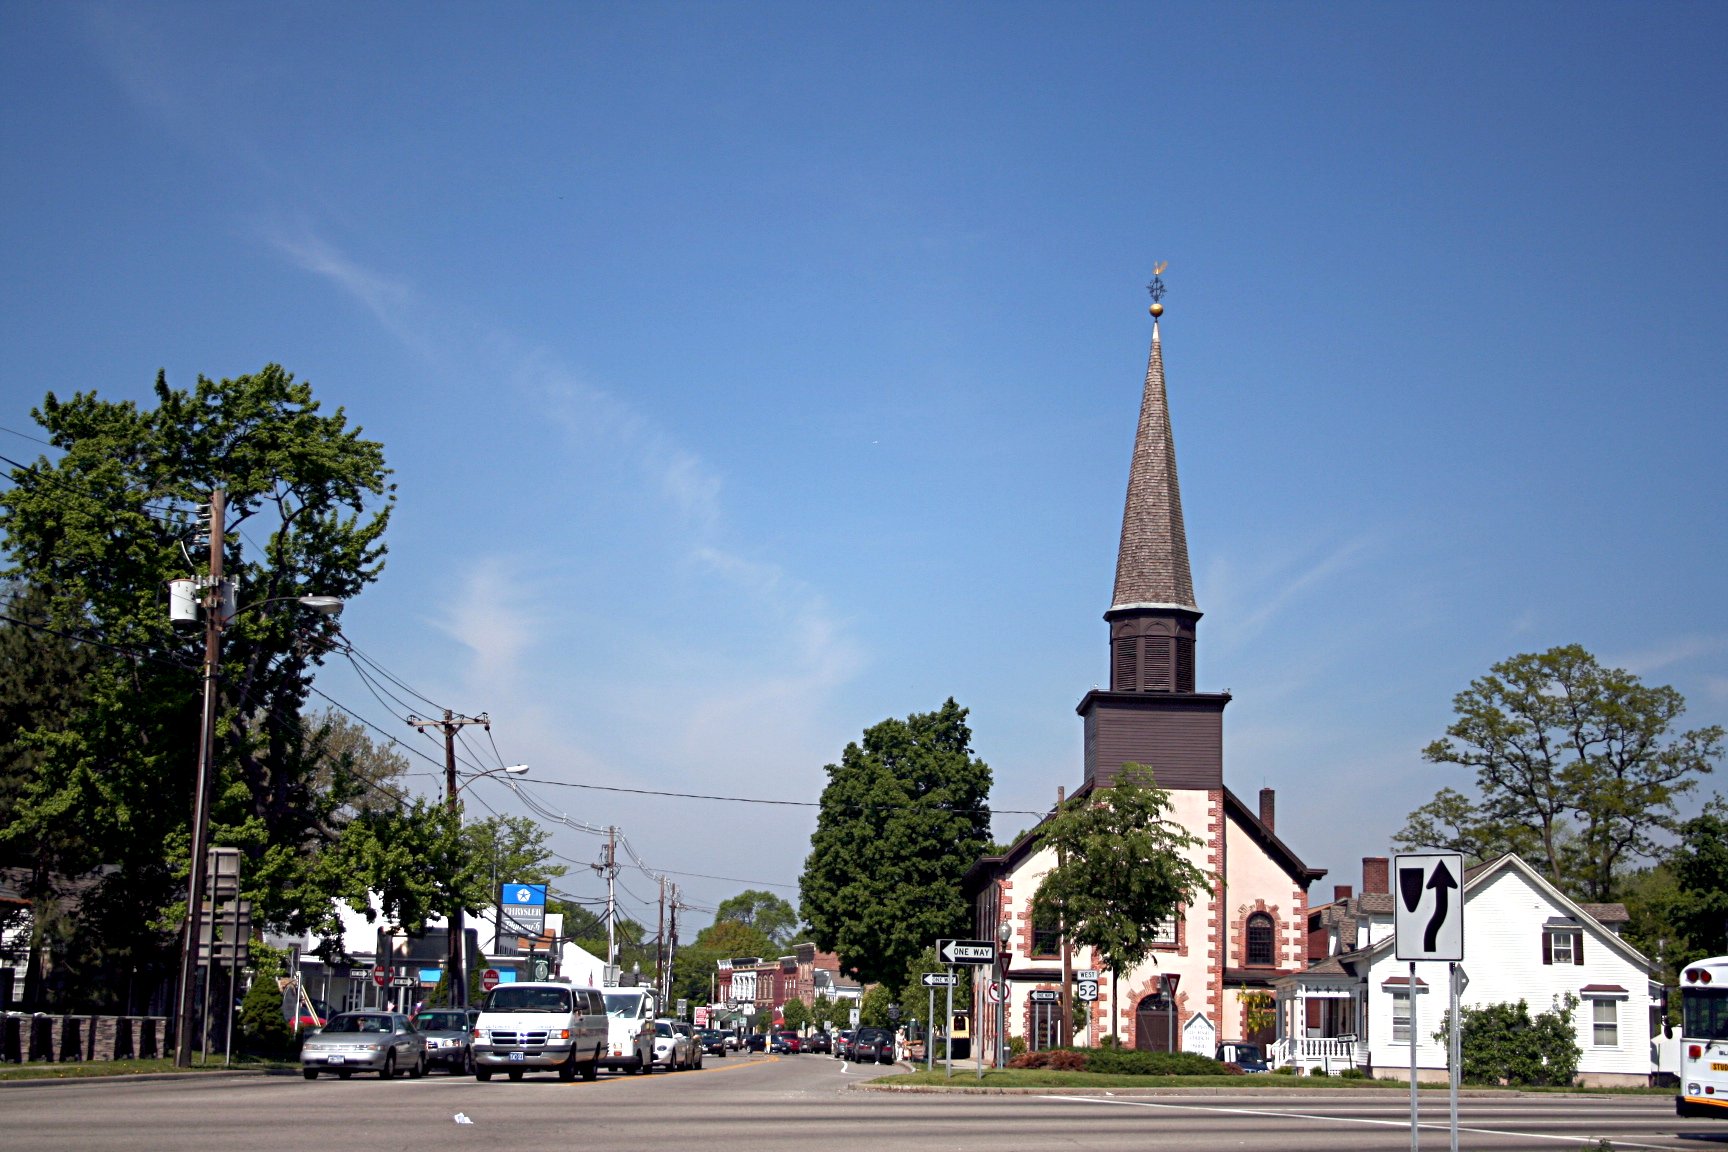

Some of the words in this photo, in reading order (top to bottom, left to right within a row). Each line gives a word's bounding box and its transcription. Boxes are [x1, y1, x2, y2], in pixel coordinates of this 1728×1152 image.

[504, 907, 541, 916] CHRYSLER
[953, 947, 969, 956] ONE
[973, 948, 990, 956] WAY
[1080, 985, 1096, 996] 52
